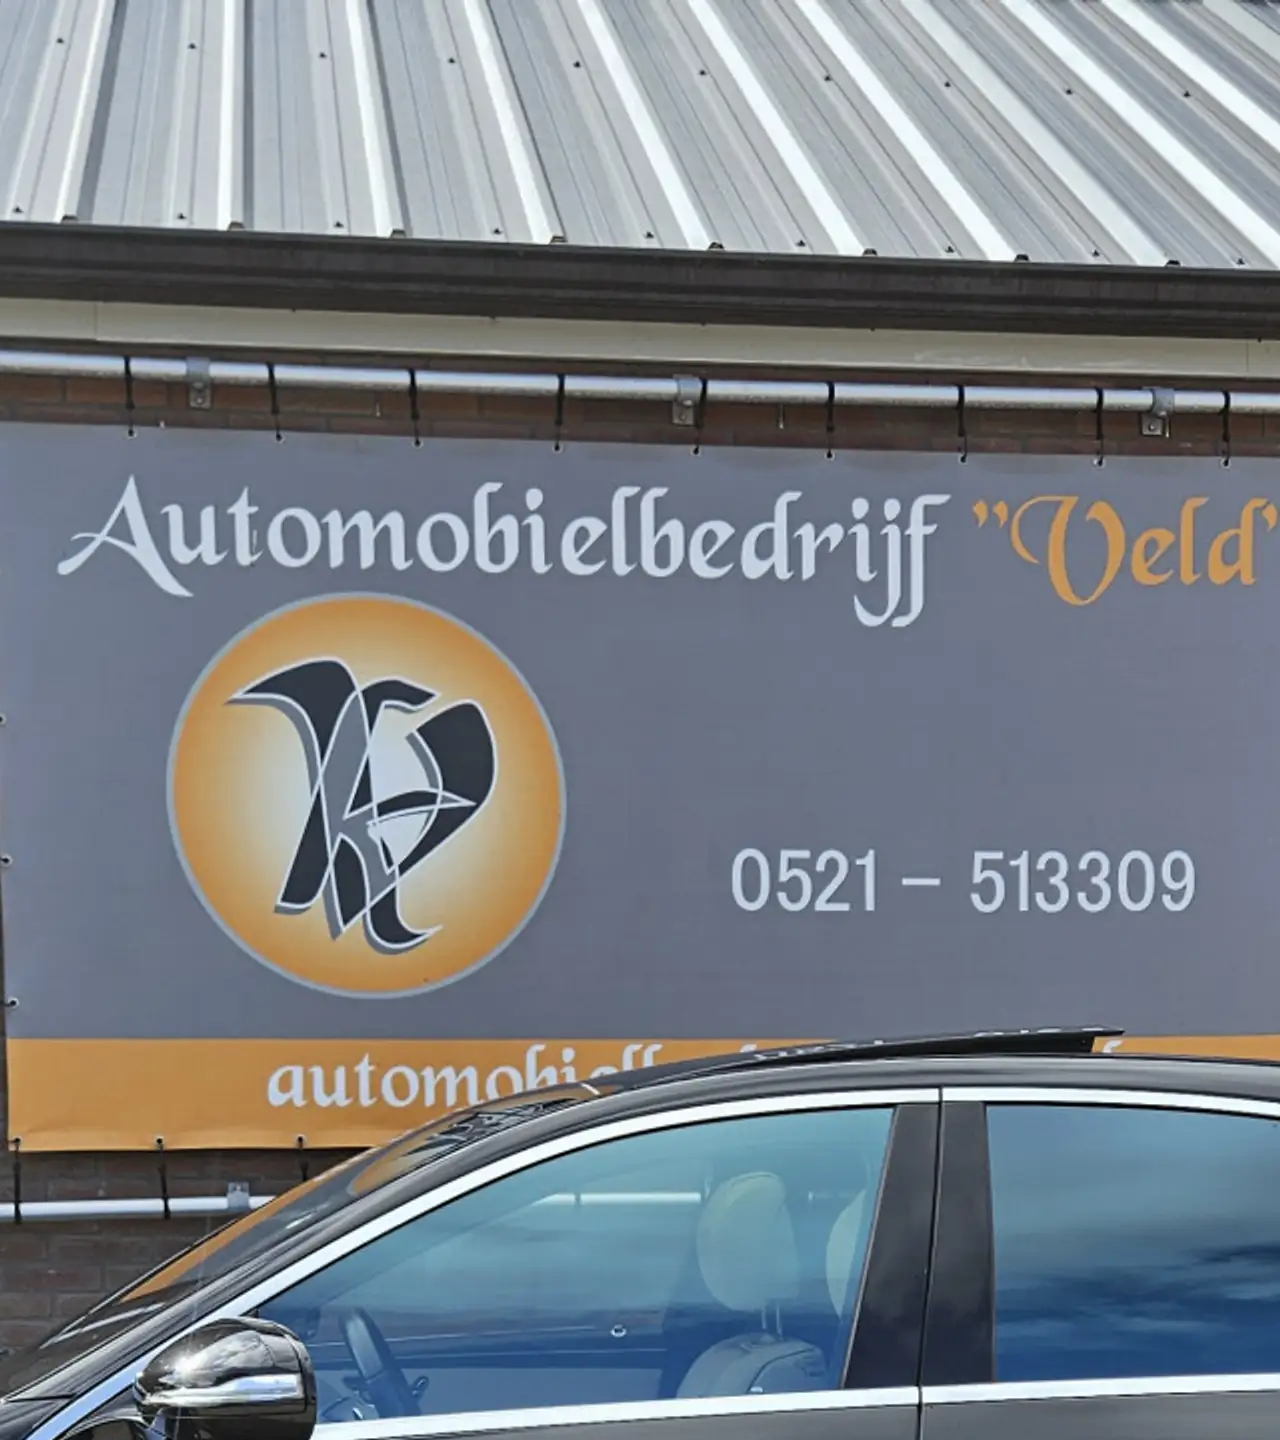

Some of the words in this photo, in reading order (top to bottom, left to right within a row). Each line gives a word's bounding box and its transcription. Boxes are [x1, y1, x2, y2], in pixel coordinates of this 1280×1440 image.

[57, 474, 951, 627] Automobielbedrijf
[731, 848, 876, 911] 0521
[970, 849, 1196, 913] 513309
